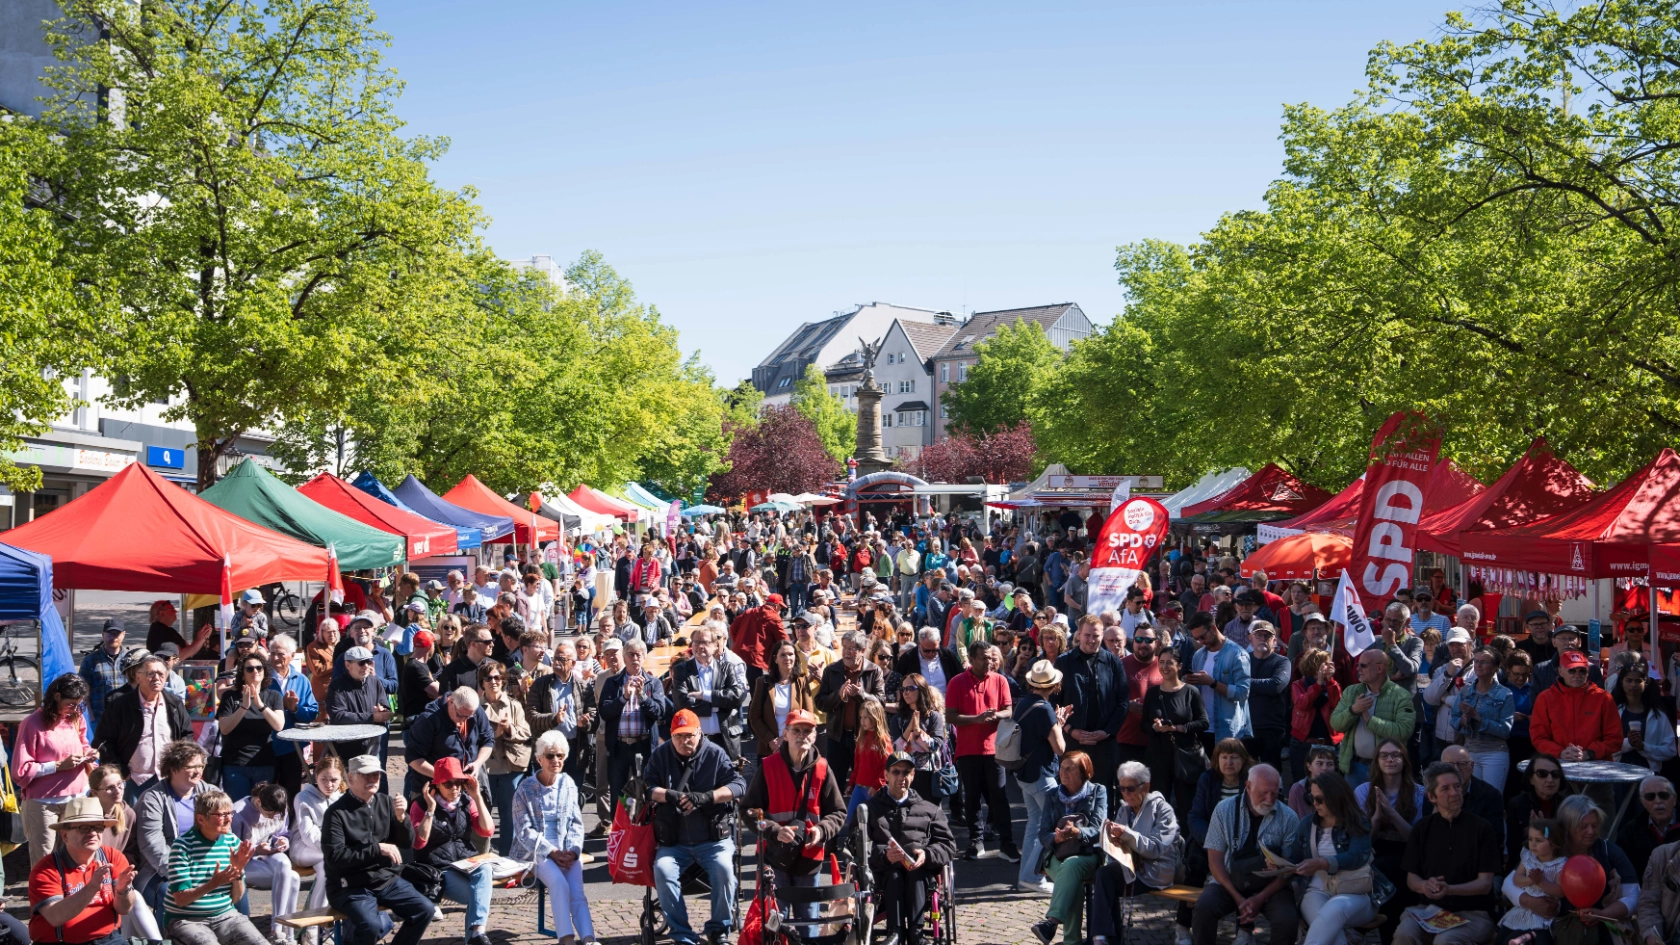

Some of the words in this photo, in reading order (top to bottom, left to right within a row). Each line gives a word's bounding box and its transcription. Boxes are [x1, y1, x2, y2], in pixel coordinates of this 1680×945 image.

[1392, 458, 1409, 470] FÜR
[1410, 462, 1429, 473] ALLE
[1405, 452, 1430, 463] ALLEN
[1108, 532, 1143, 548] SPD
[1362, 479, 1424, 598] SPD
[1108, 549, 1139, 565] AfA
[1346, 604, 1367, 634] AWO
[894, 750, 909, 760] VIP
